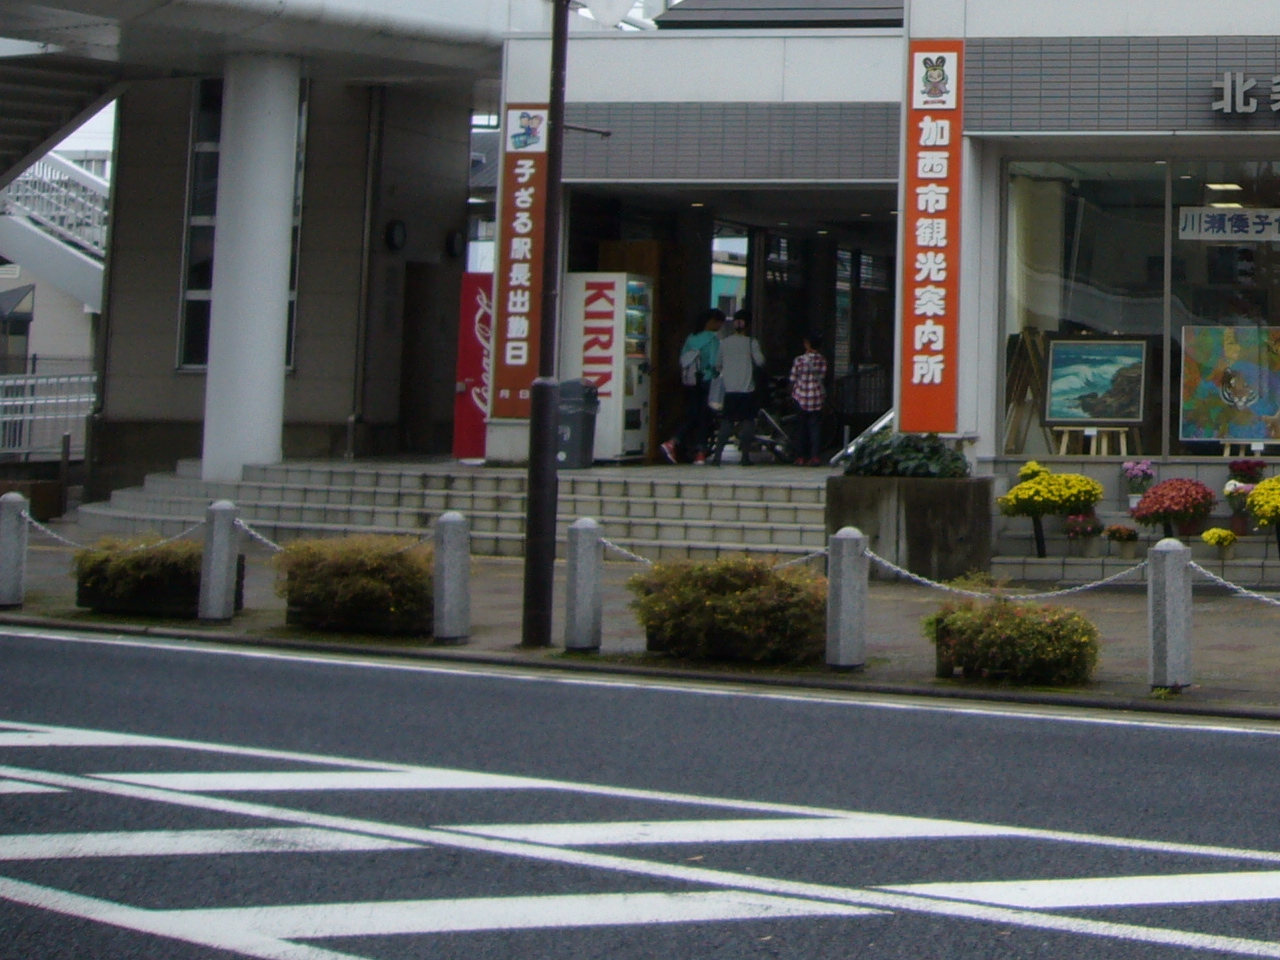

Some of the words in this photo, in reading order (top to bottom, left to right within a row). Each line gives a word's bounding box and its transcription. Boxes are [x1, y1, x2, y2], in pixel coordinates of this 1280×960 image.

[505, 159, 536, 366] 子ざる駅長出勤日
[911, 115, 950, 384] 加西市観光案内所
[499, 389, 510, 399] 月
[519, 389, 530, 399] 日
[582, 280, 616, 398] KIRIN
